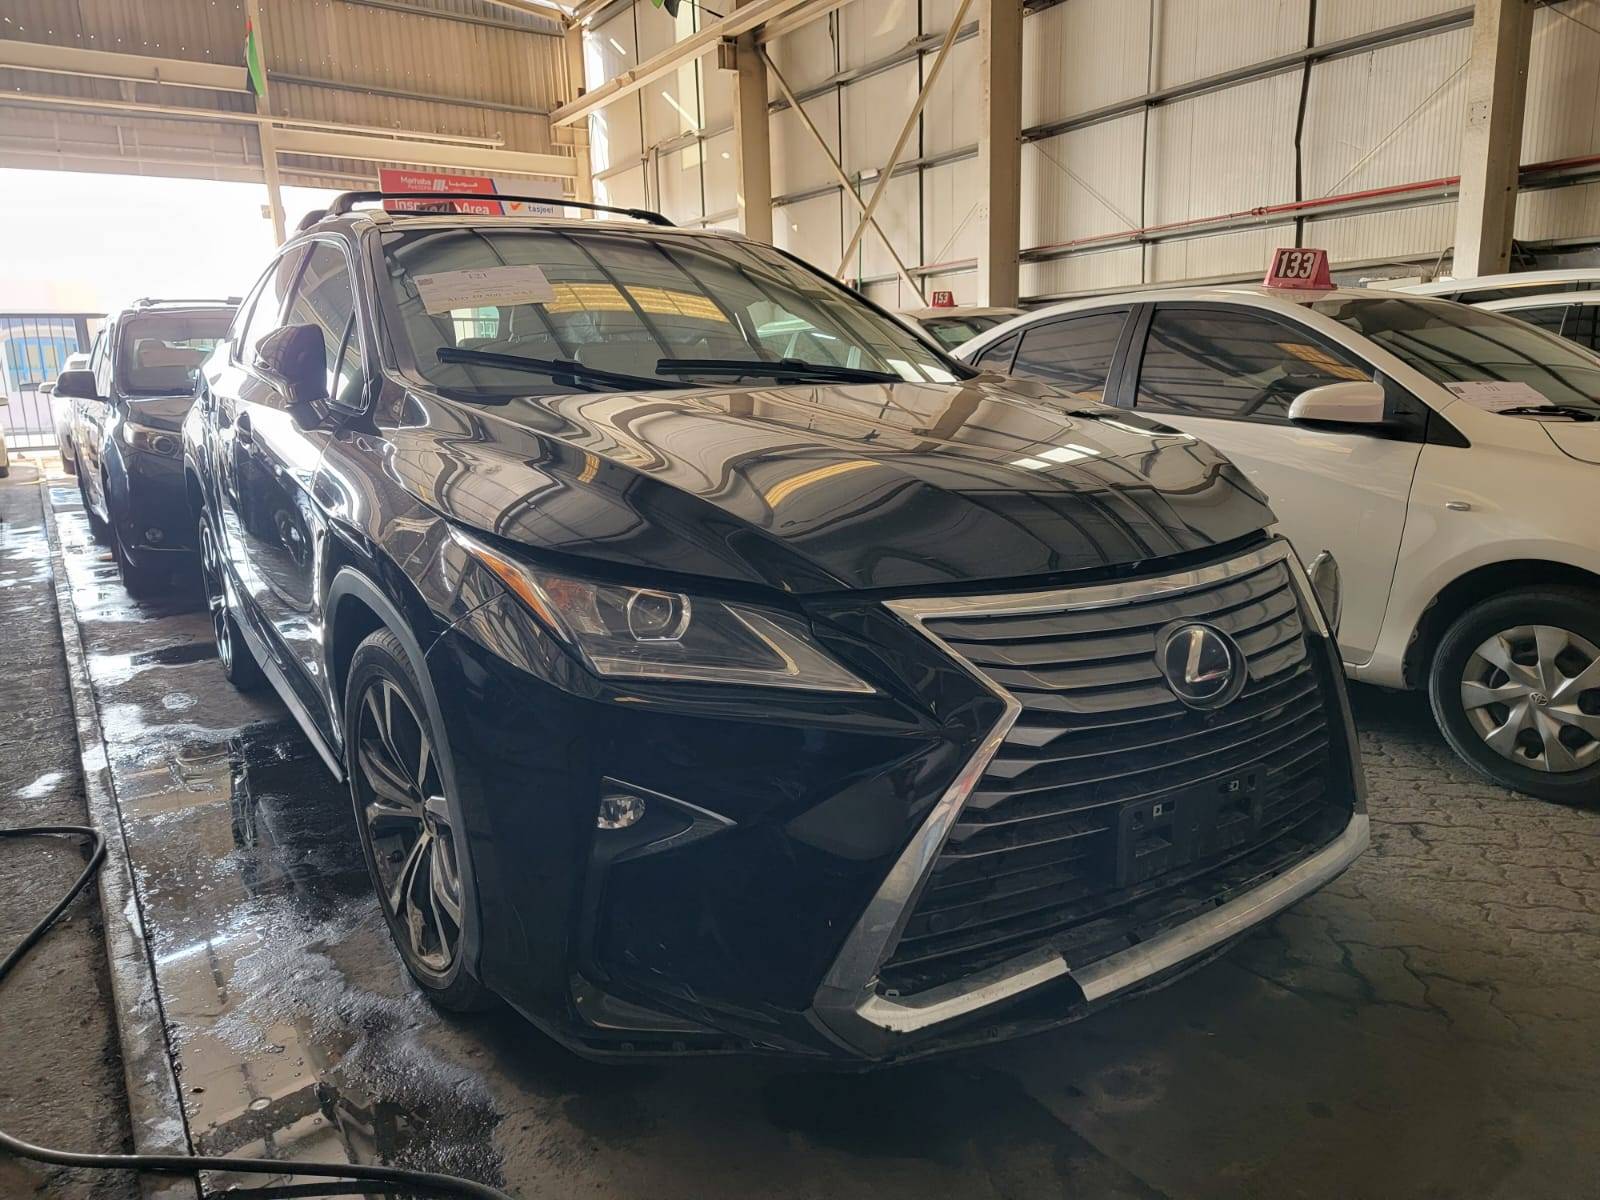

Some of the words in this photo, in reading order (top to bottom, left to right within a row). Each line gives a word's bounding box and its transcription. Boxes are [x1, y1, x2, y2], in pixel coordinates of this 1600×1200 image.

[462, 202, 490, 215] Area
[528, 204, 554, 215] tasjeel
[1278, 251, 1315, 279] 133
